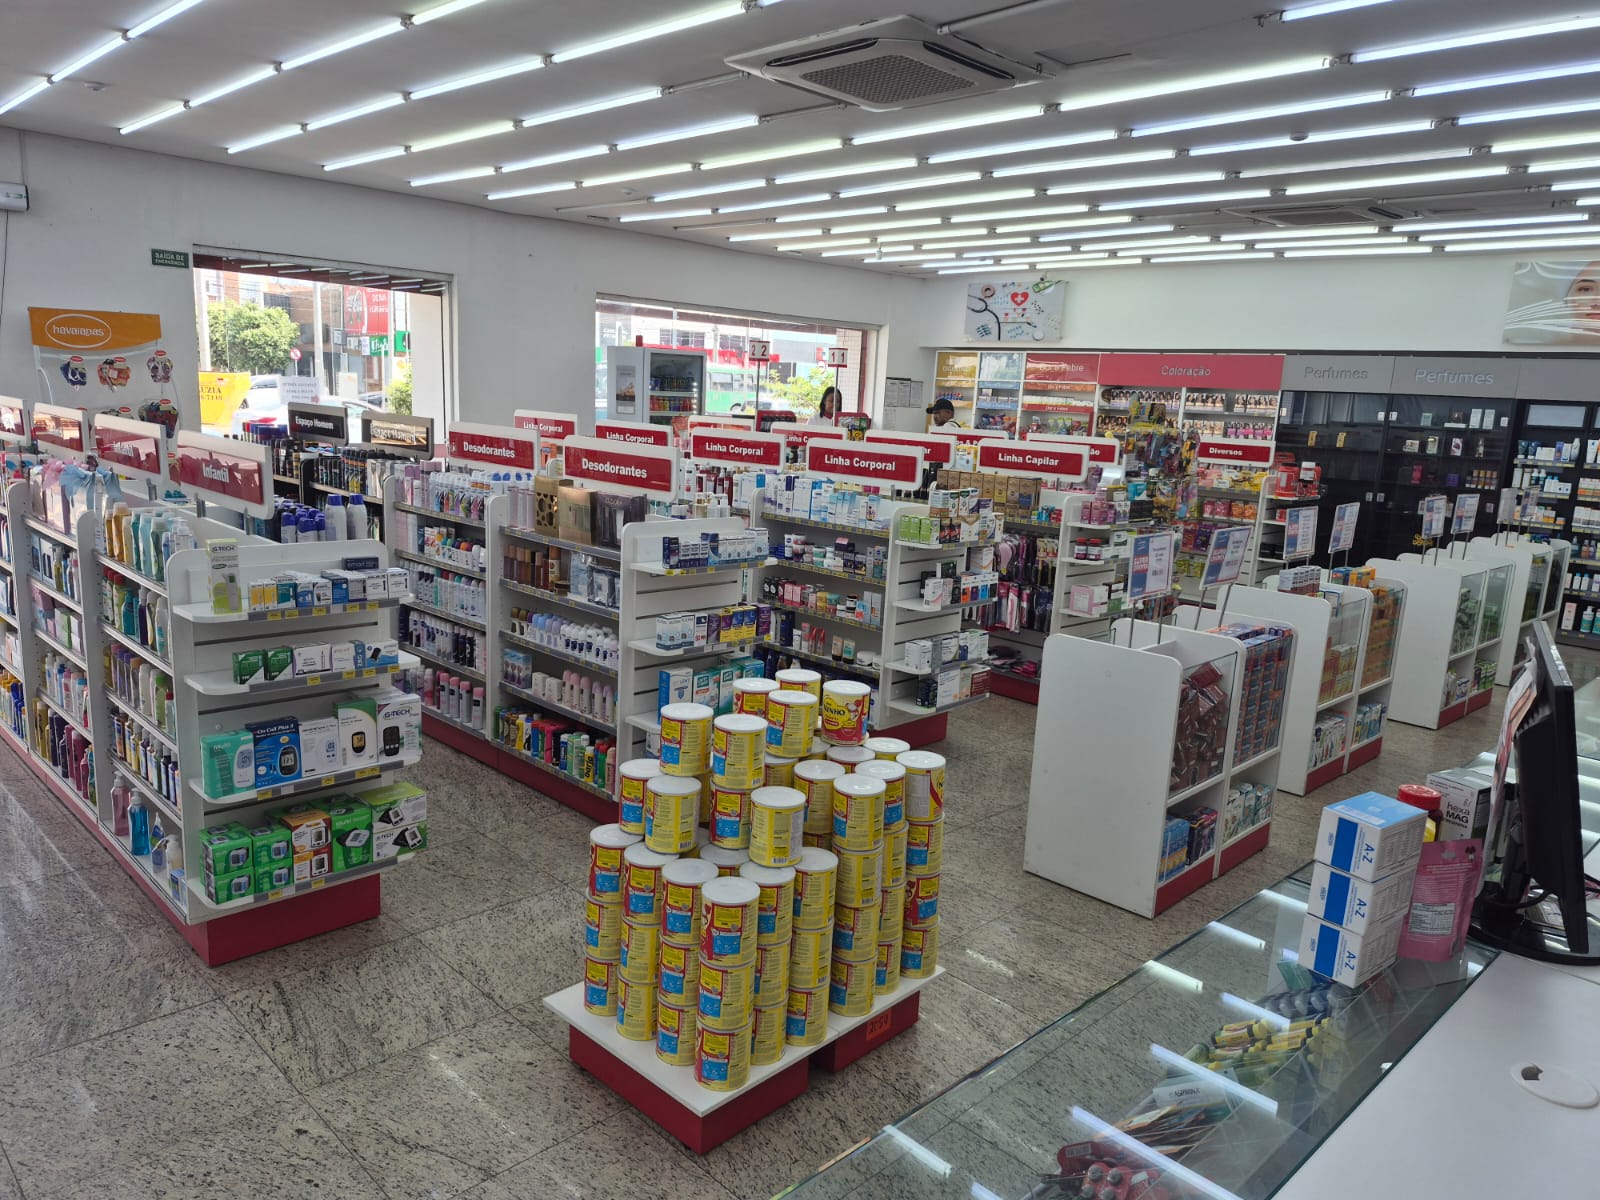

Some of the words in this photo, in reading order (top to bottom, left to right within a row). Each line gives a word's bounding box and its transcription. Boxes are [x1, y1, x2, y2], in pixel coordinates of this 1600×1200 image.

[751, 344, 756, 356] 2
[761, 344, 767, 356] 2
[1161, 365, 1211, 377] Coloração
[1304, 366, 1368, 380] Perfumes
[1415, 368, 1494, 385] Perfumes
[295, 415, 313, 427] Espaço
[313, 418, 334, 430] Homem
[523, 421, 538, 431] Linha
[539, 423, 563, 434] Corporal
[606, 431, 624, 442] Linha
[625, 433, 654, 444] Corporal
[463, 441, 515, 459] Desodorantes
[705, 442, 727, 452] Linha
[728, 444, 764, 457] Corporal
[1209, 447, 1243, 456] Diversos
[824, 454, 850, 466] Linha
[853, 457, 896, 471] Corporal
[998, 453, 1023, 464] Linha
[1025, 454, 1059, 467] Capilar
[202, 462, 230, 483] Infantil
[582, 458, 648, 479] Desodorantes
[384, 708, 410, 719] G-TECH
[1447, 801, 1470, 816] hexa
[1446, 810, 1469, 825] MAG
[1362, 842, 1376, 864] A-Z
[1355, 897, 1367, 919] A-Z
[1344, 949, 1357, 971] A-Z
